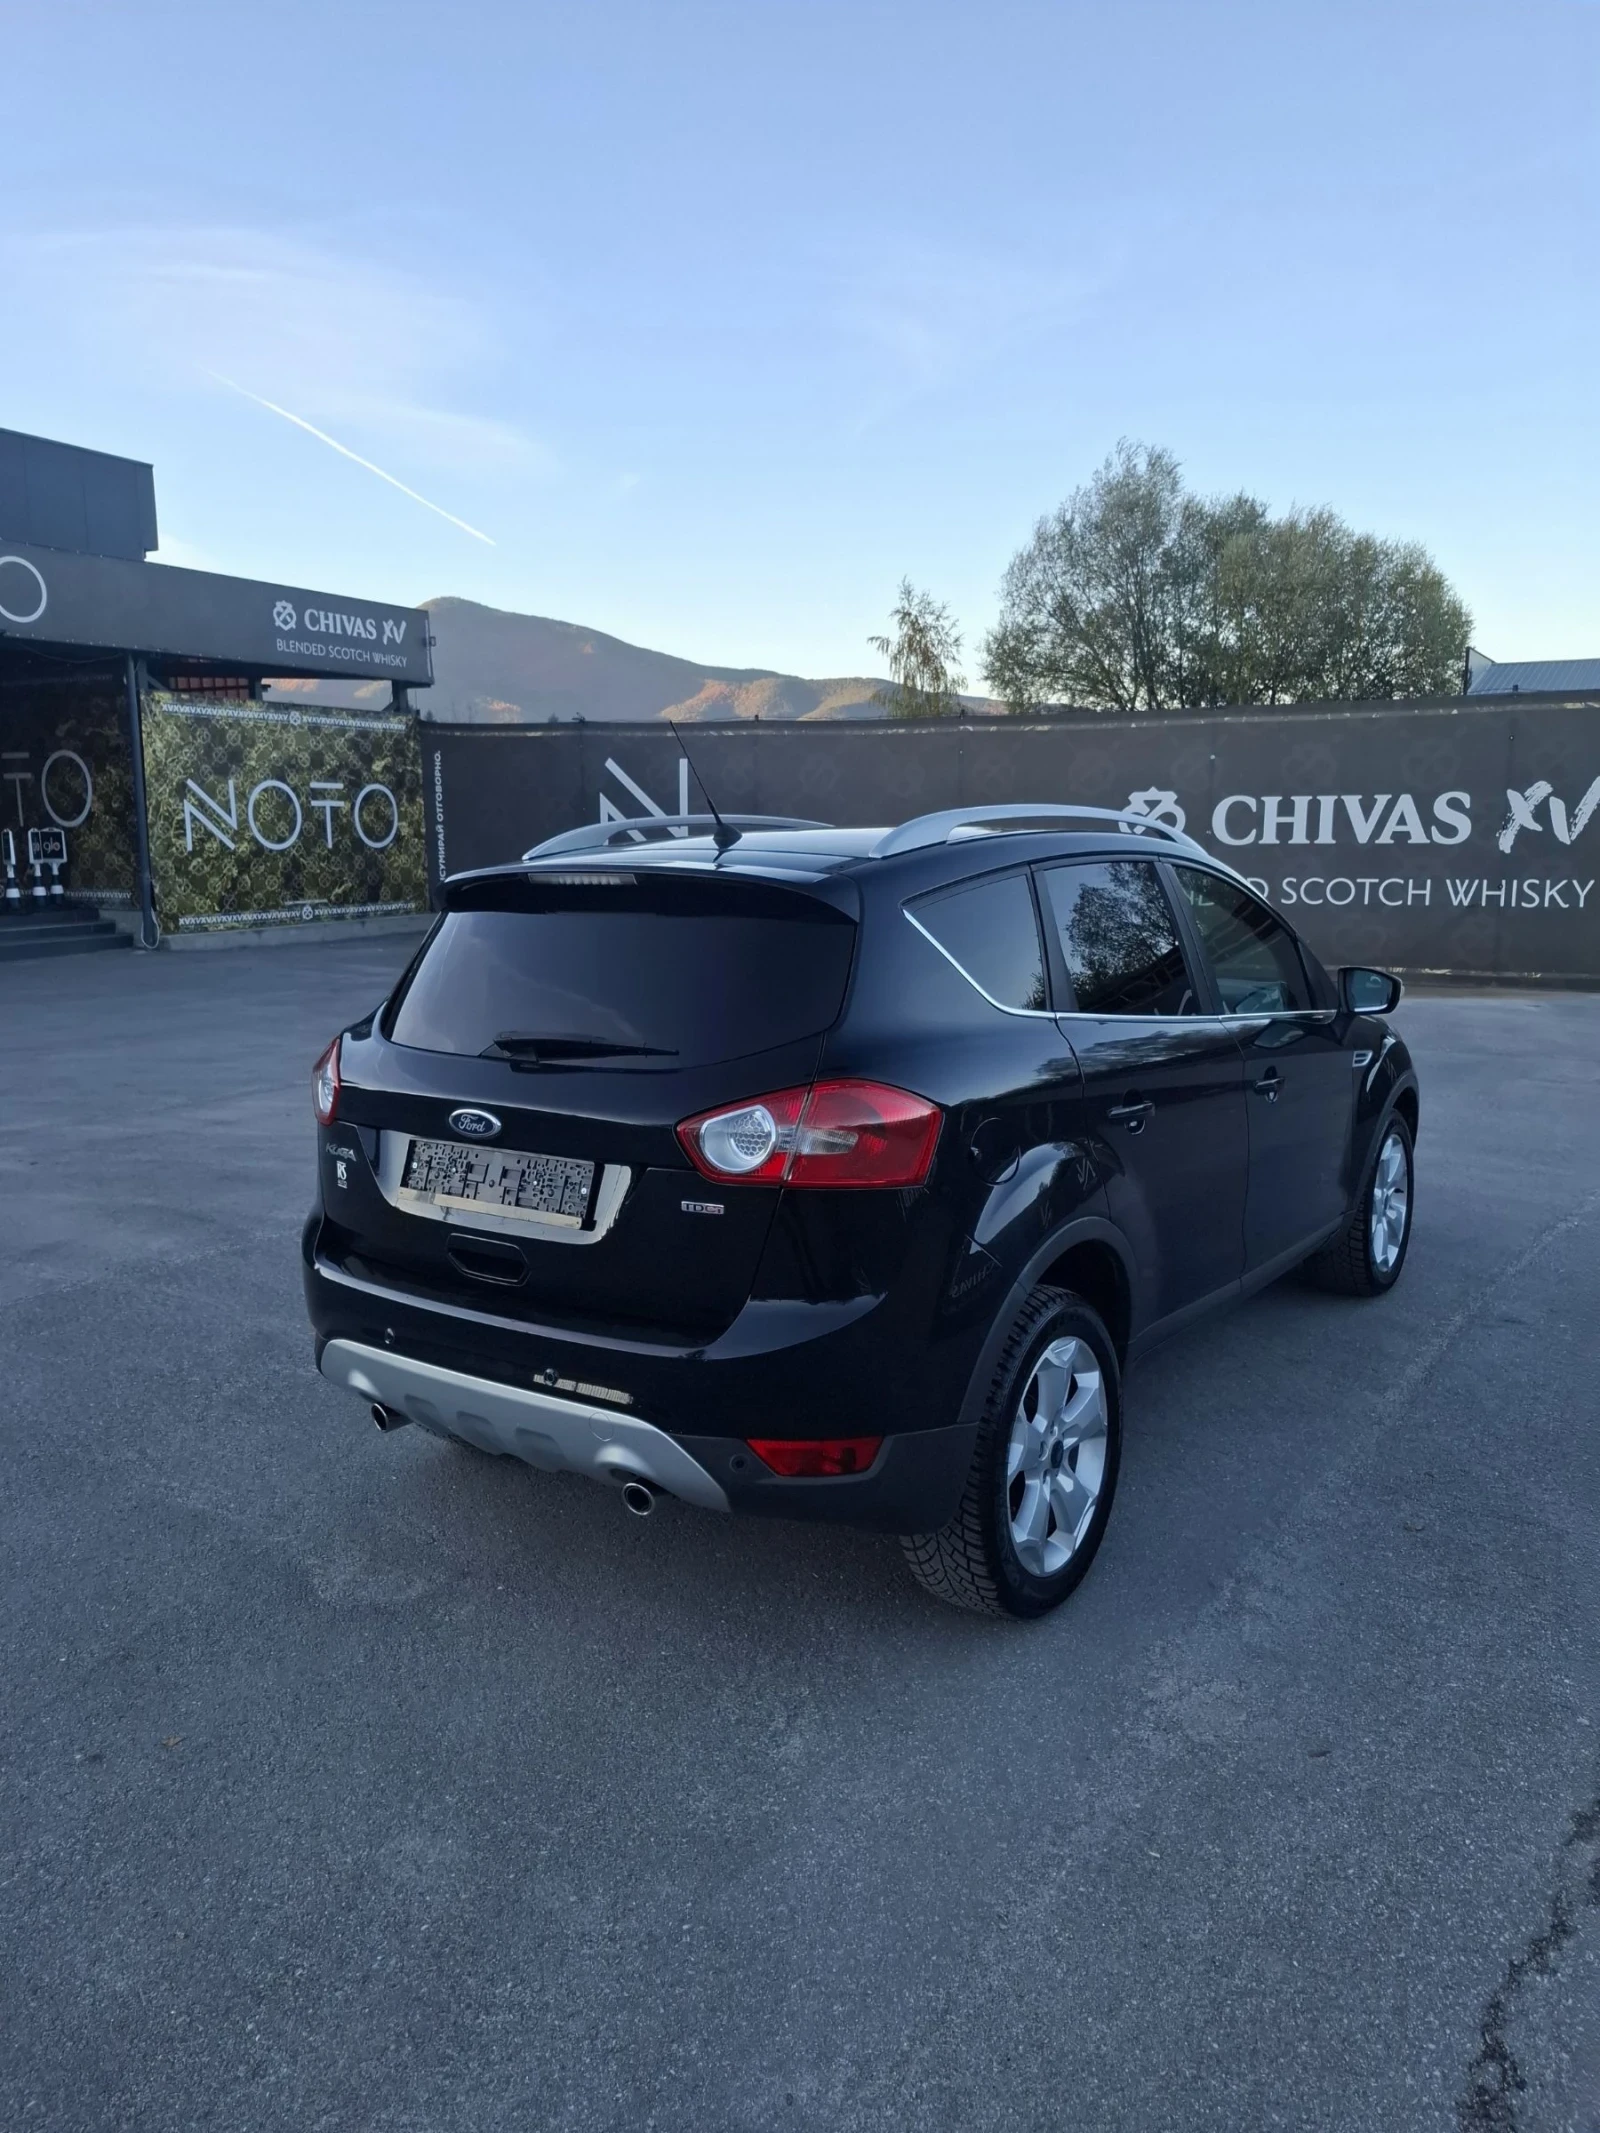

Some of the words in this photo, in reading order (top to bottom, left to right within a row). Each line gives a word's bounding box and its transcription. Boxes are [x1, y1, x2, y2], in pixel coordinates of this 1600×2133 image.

[304, 608, 377, 640] CHIVAS
[383, 619, 407, 645] XV
[276, 638, 326, 657] BLENDED
[329, 645, 371, 663] SCOTCH
[372, 652, 408, 668] WHISKY
[434, 750, 444, 822] ОТГОВОРНО.
[183, 779, 398, 851] NOTO
[1211, 791, 1472, 846] CHIVAS
[1496, 776, 1600, 853] XV
[43, 836, 61, 854] glo
[1280, 877, 1432, 907] SCOTCH
[1445, 878, 1595, 908] WHISKY
[458, 1113, 486, 1132] Ford
[325, 1142, 357, 1162] KUGA
